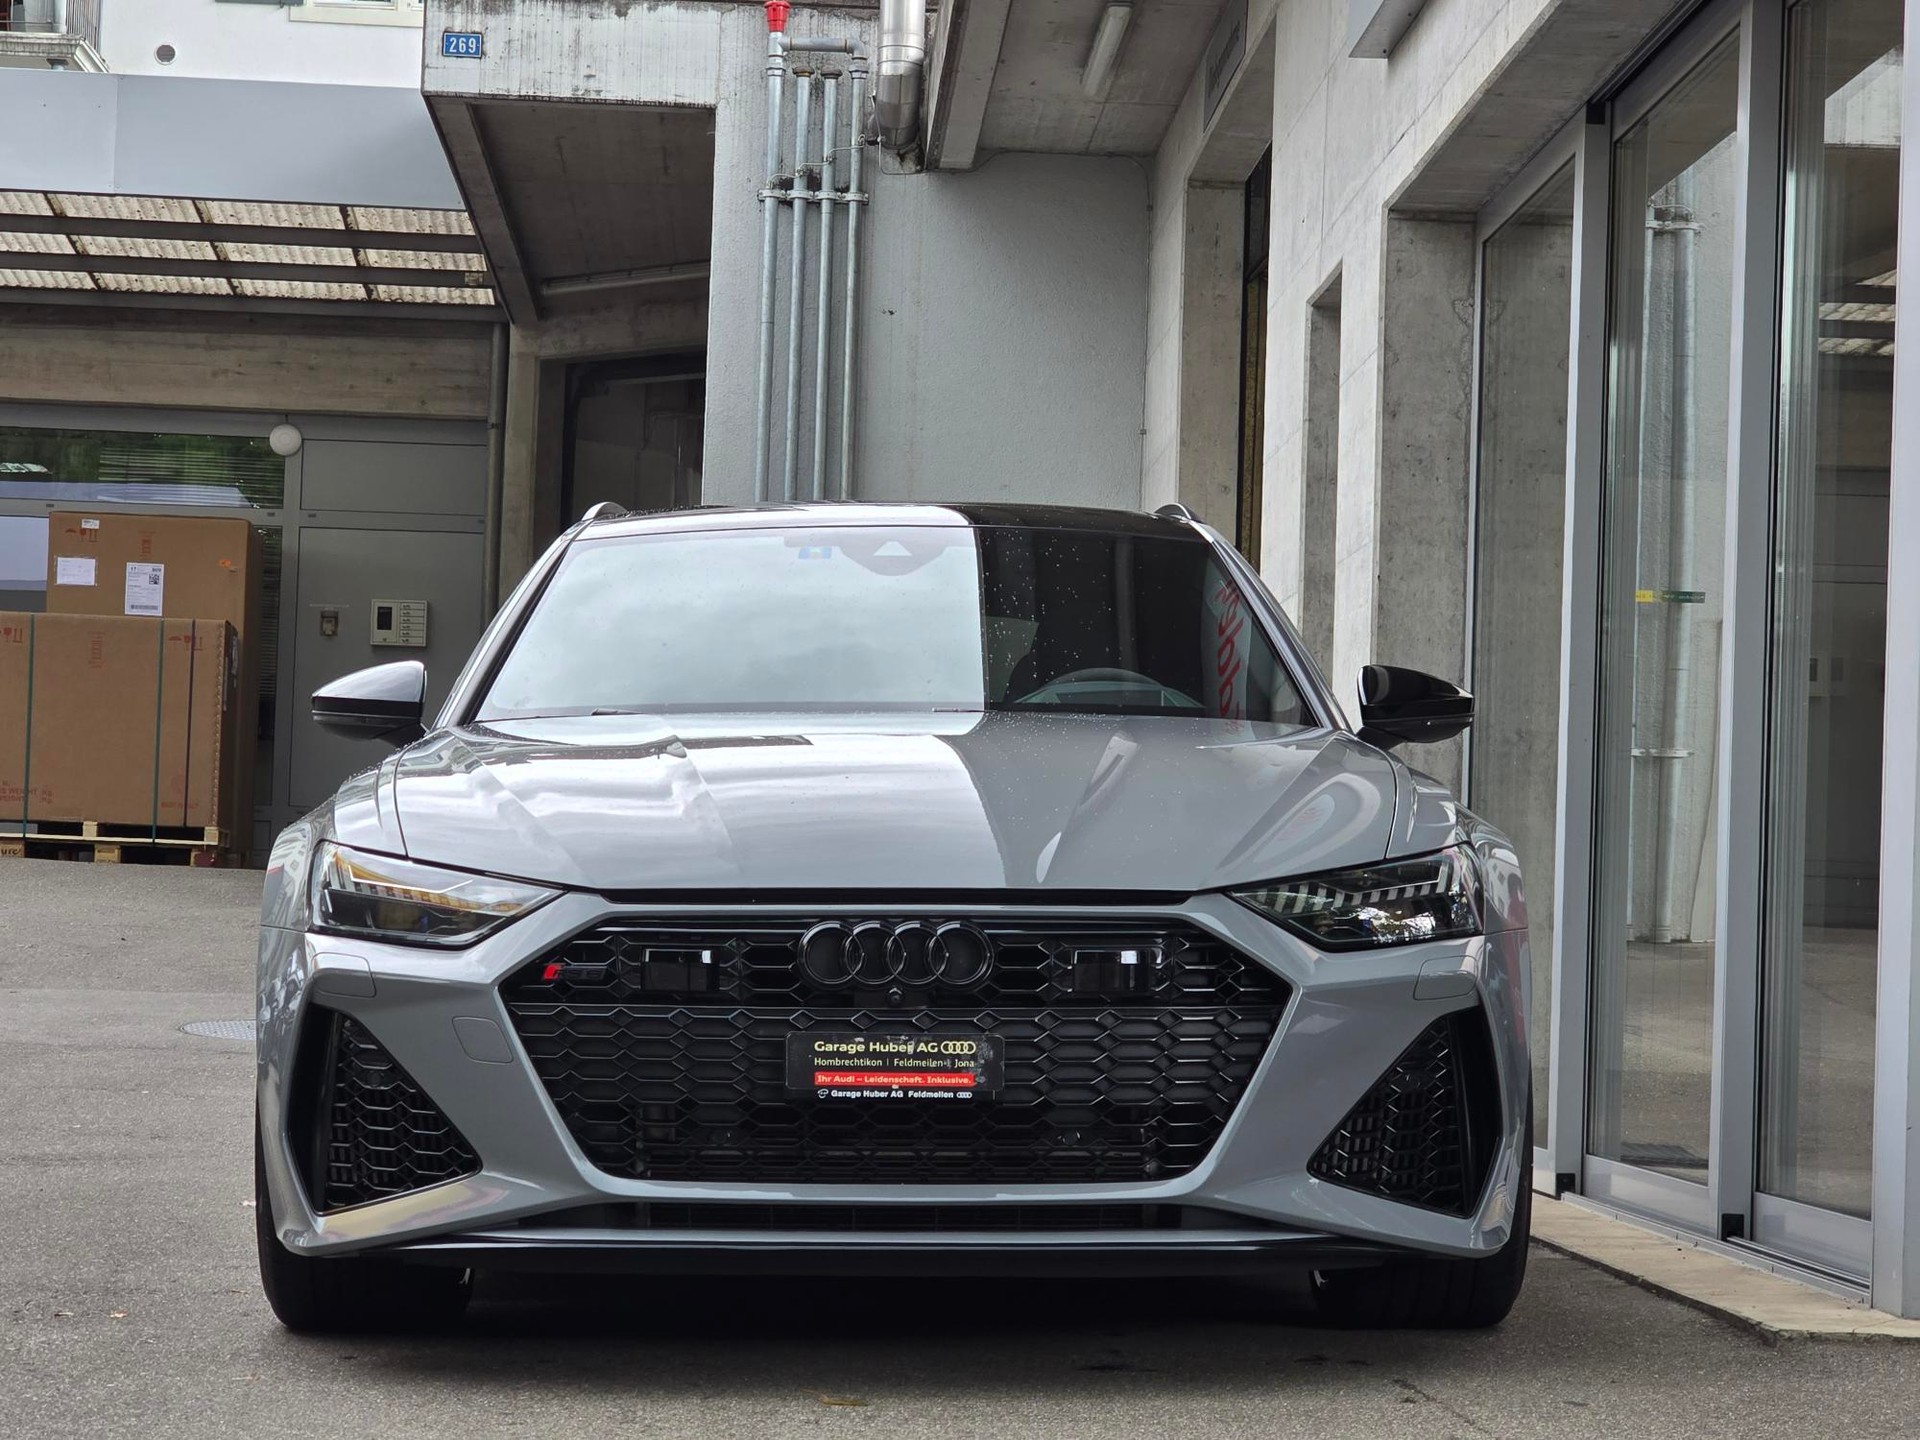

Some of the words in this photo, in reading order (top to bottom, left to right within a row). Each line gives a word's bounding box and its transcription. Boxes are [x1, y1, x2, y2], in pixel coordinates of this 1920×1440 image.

[449, 37, 477, 53] 269
[814, 1041, 866, 1054] Garage
[916, 1042, 939, 1053] AG
[814, 1057, 883, 1067] Hombrechtikon
[893, 1058, 943, 1068] Feldmeilen
[953, 1059, 975, 1069] Jona
[817, 1075, 832, 1083] Ihr
[833, 1075, 855, 1083] Audi
[864, 1075, 926, 1084] Leidenschaft.
[927, 1076, 972, 1084] Inklusive.
[831, 1089, 861, 1099] Garage
[863, 1090, 889, 1098] Huber
[890, 1090, 904, 1098] AG
[908, 1090, 954, 1099] Feldmeilen
